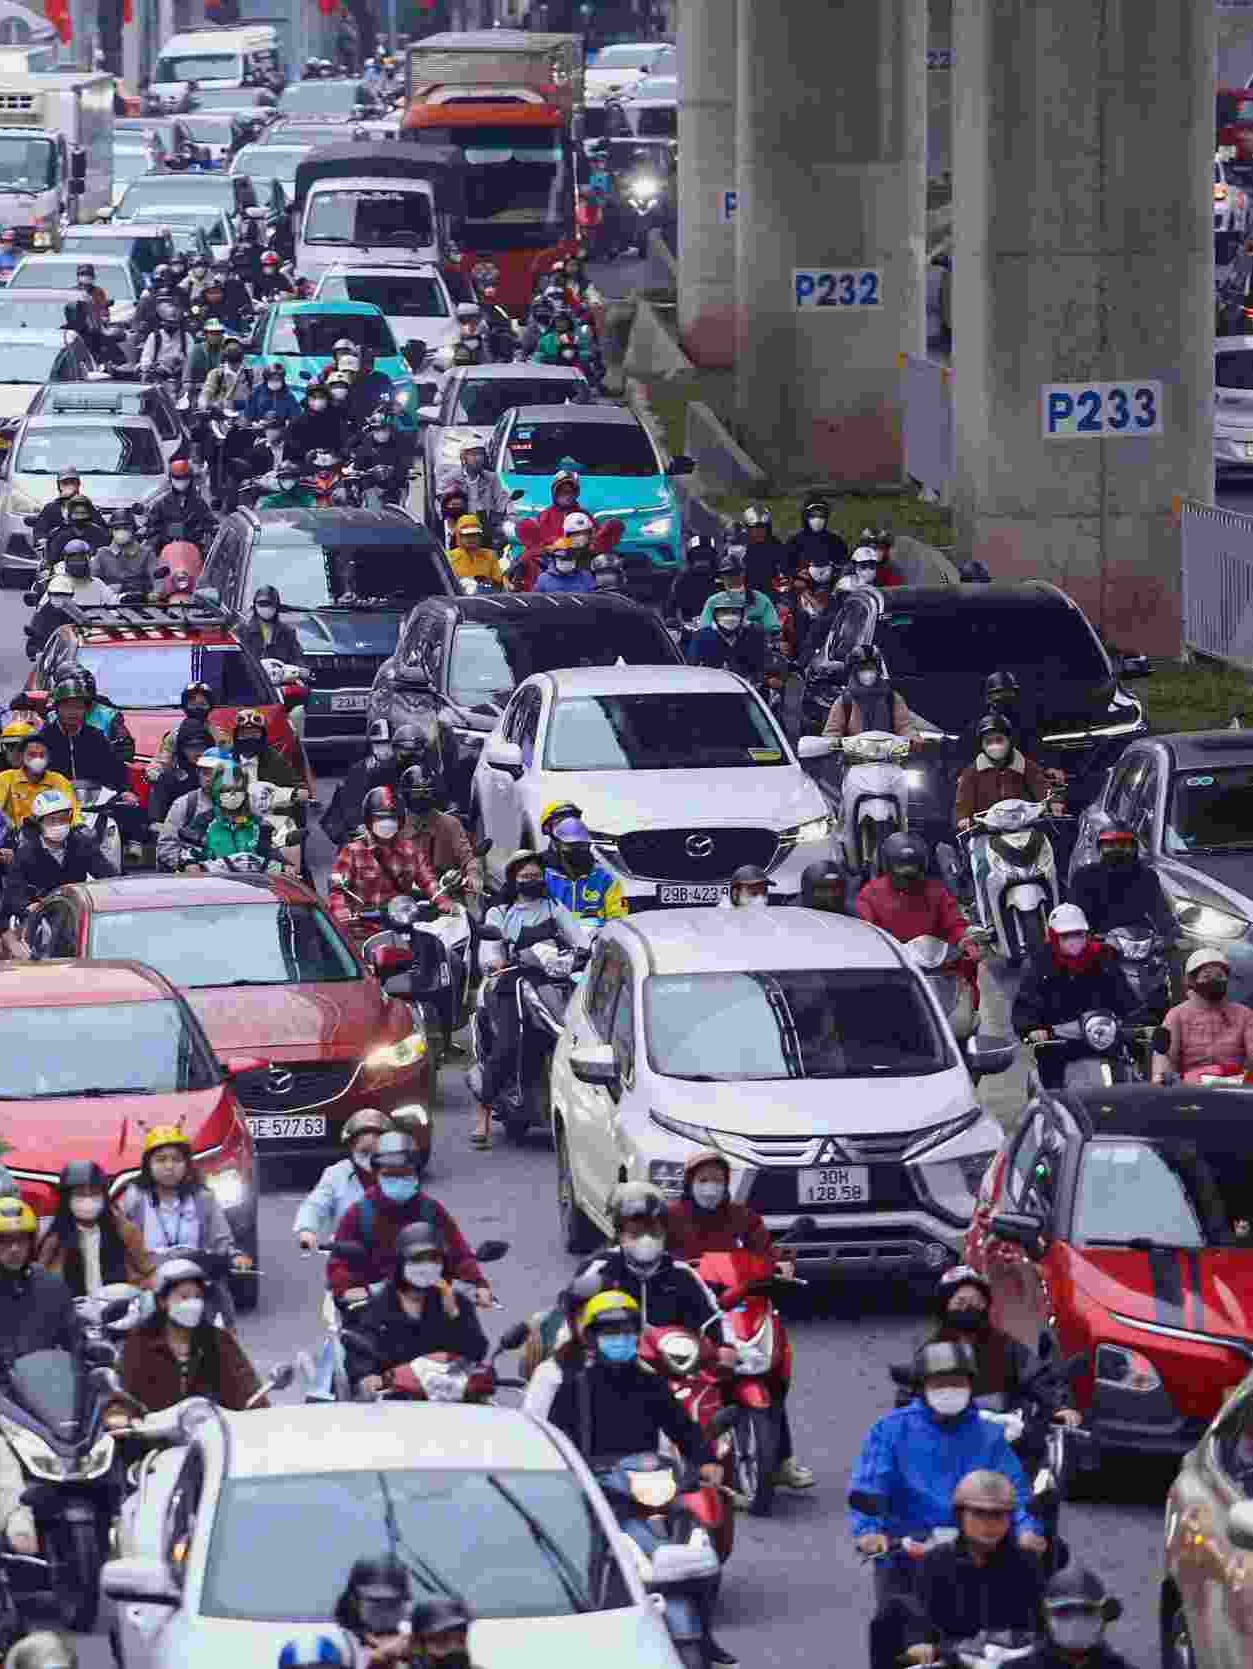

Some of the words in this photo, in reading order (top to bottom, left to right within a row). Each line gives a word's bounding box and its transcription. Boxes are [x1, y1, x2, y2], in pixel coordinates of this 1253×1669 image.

[796, 273, 879, 307] P232
[1048, 388, 1157, 433] P233
[820, 1170, 850, 1185] 30H
